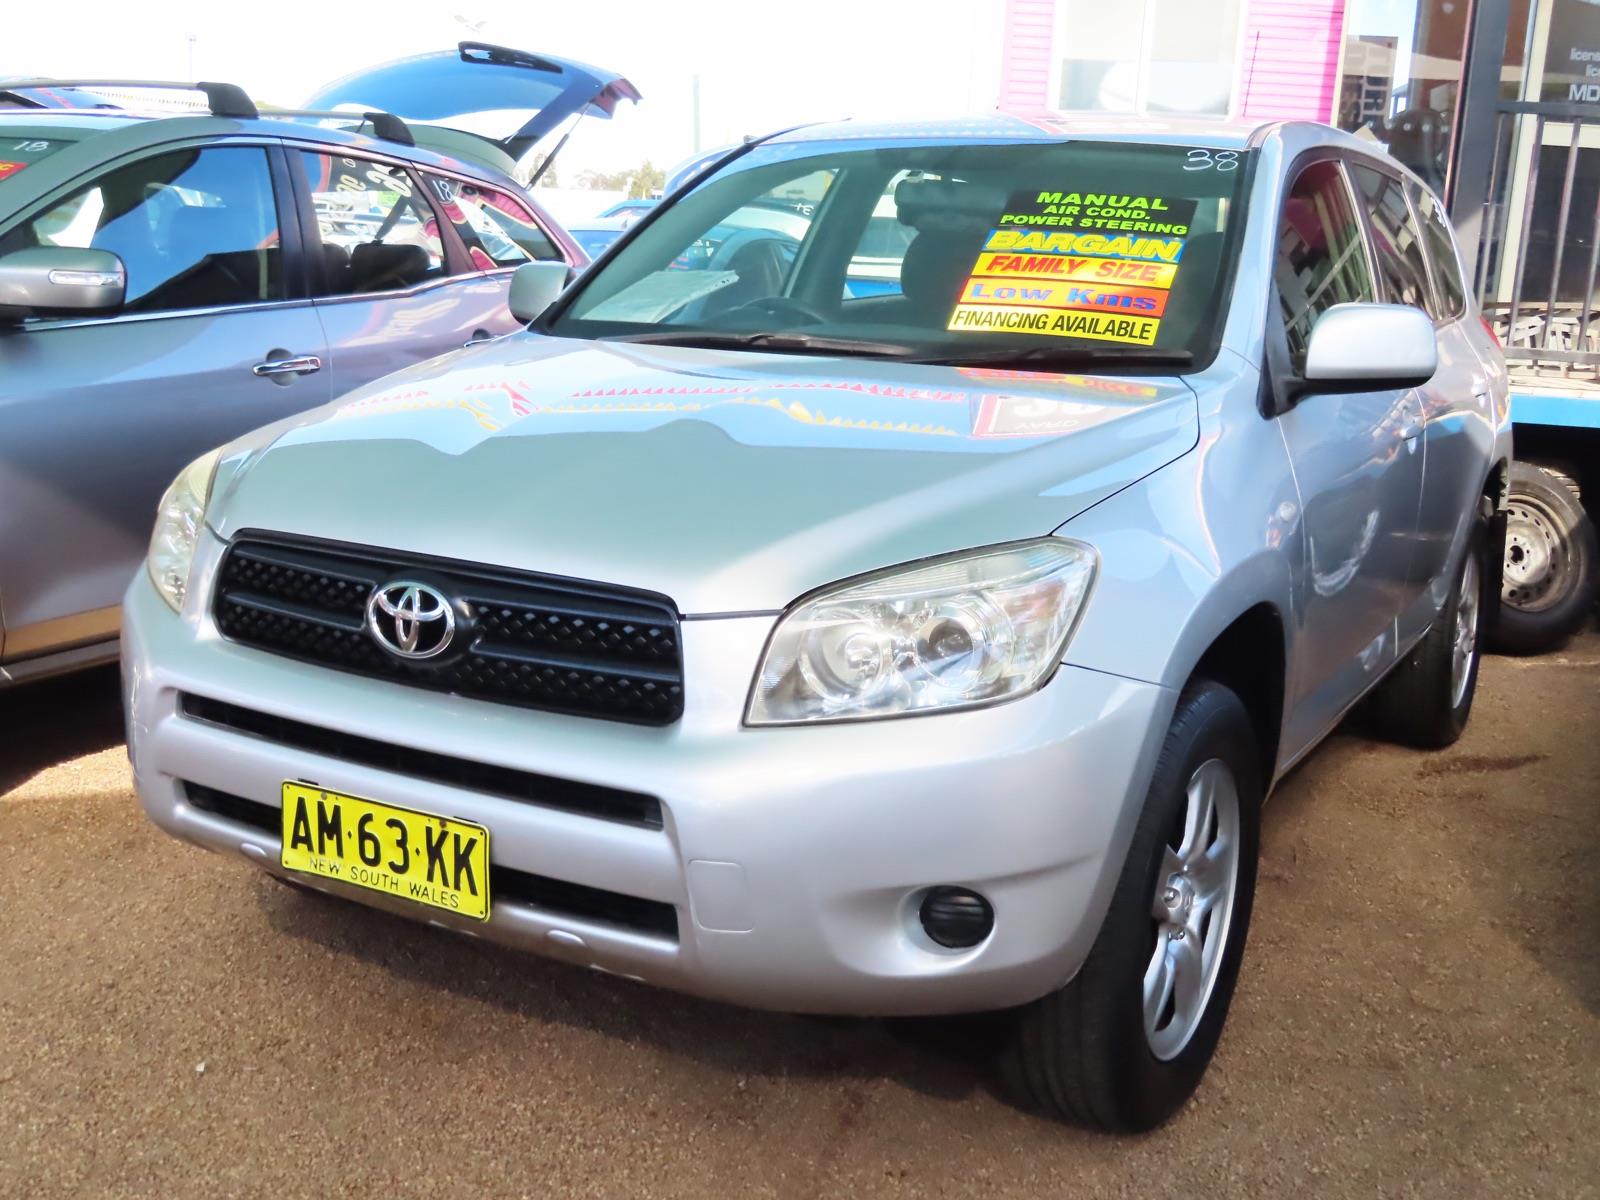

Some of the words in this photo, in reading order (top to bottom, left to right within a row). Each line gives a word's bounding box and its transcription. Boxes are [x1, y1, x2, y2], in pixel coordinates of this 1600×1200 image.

[1183, 149, 1239, 172] 38
[432, 179, 454, 203] 18
[1036, 191, 1169, 211] MANUAL
[1000, 215, 1074, 227] POWER
[1079, 218, 1190, 235] STEERING
[1043, 205, 1080, 215] AIR
[1086, 207, 1151, 220] COND.
[985, 230, 1183, 262] BARGAIN
[985, 255, 1087, 275] FAMILY
[1095, 261, 1162, 282] SIZE
[970, 283, 1053, 300] Low
[1066, 288, 1157, 310] Kms
[954, 310, 1049, 330] FINANCING
[1051, 315, 1153, 341] AVAILABLE
[309, 855, 341, 875] NEW
[350, 866, 400, 891] SOUTH
[409, 881, 460, 909] WALES
